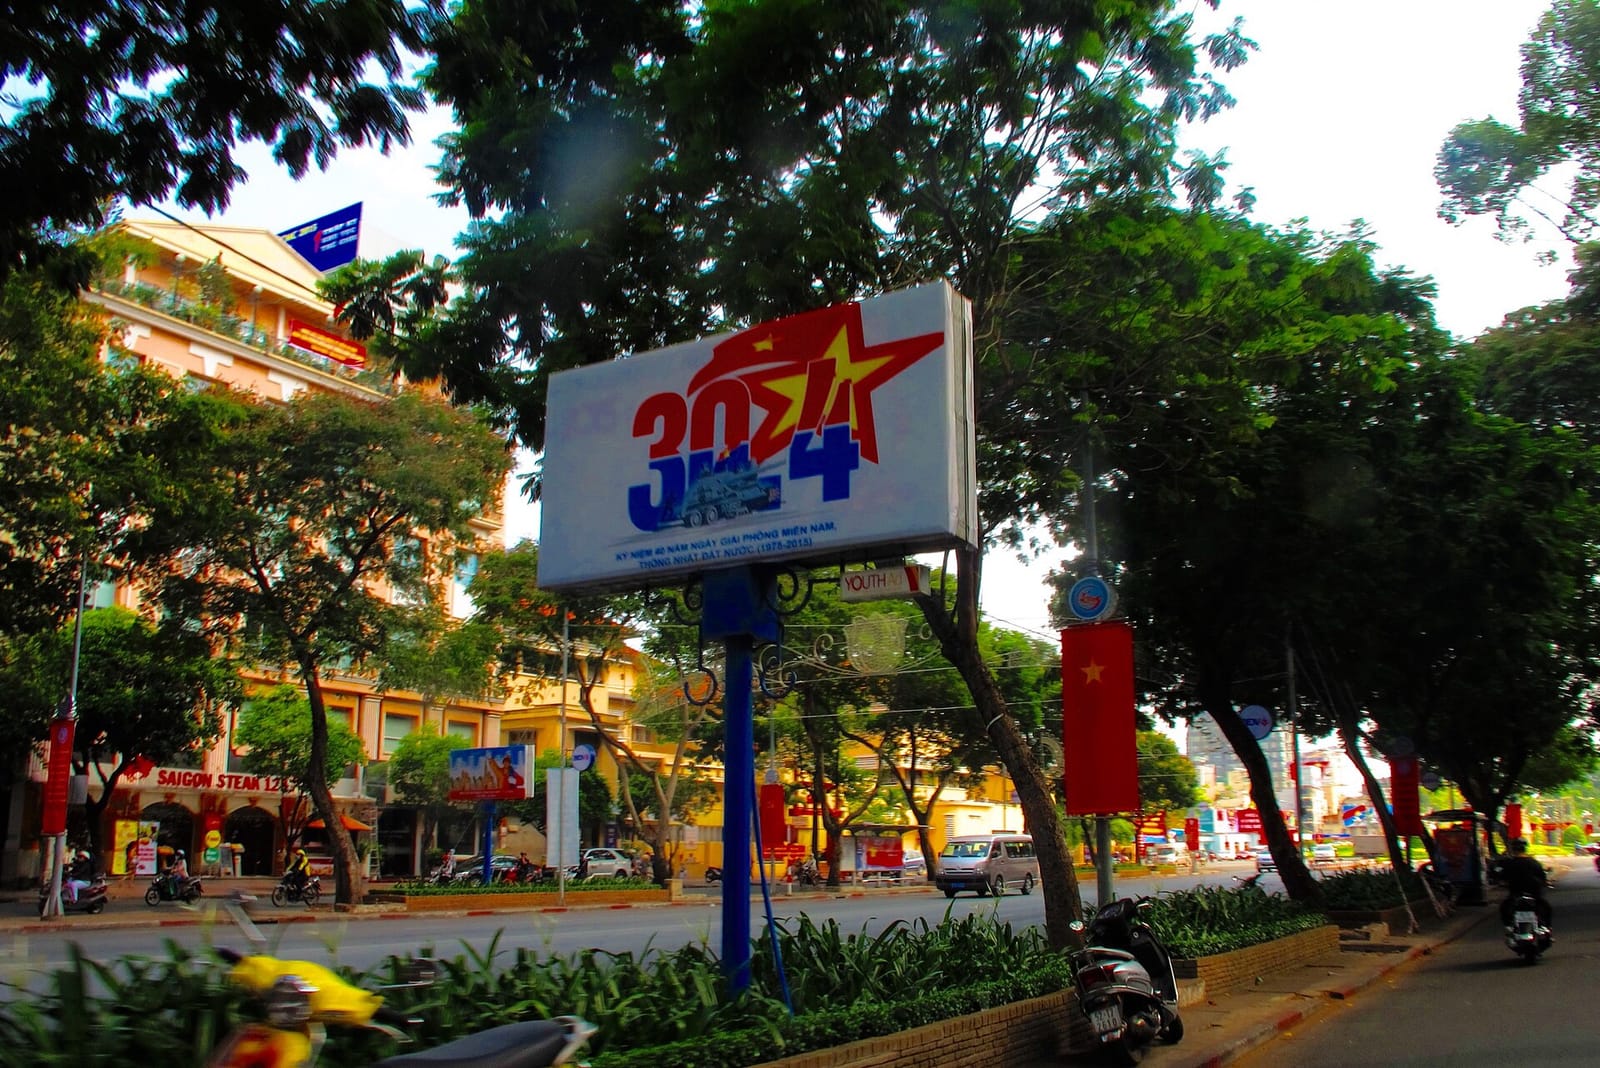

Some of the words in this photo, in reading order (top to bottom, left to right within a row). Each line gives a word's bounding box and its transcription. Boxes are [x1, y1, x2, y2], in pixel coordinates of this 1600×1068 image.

[845, 573, 887, 592] YOUTH
[157, 770, 213, 788] SAIGON
[216, 774, 260, 791] STEAK
